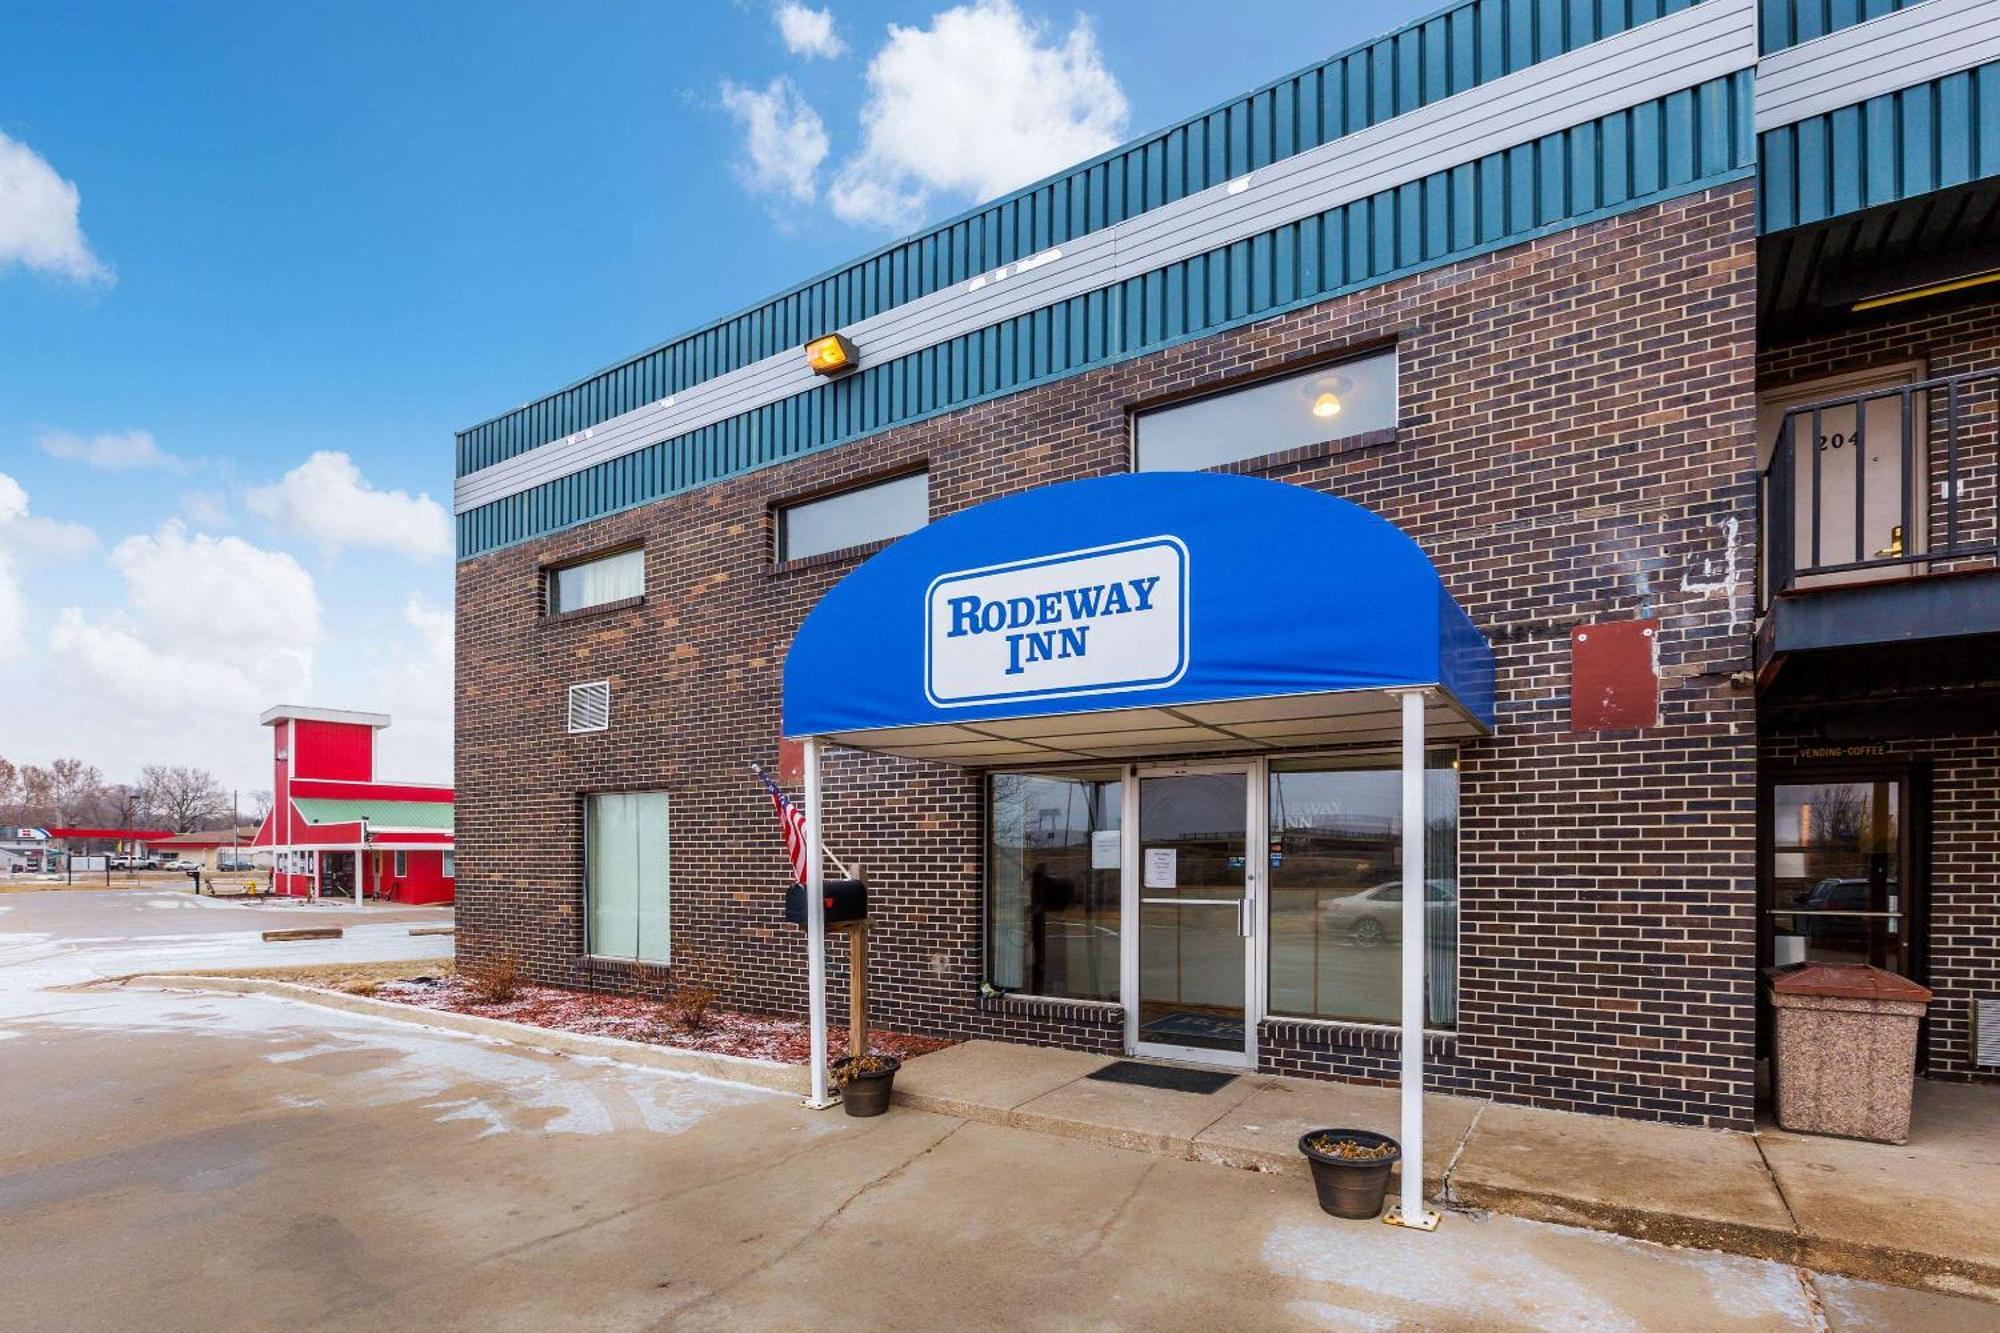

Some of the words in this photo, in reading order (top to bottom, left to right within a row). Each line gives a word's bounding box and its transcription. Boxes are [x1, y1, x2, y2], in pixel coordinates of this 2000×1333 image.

[1819, 432, 1858, 451] 204
[947, 576, 1160, 638] RODEWAY
[1005, 626, 1090, 675] INN
[1800, 745, 1886, 758] VENDING-COFFEE
